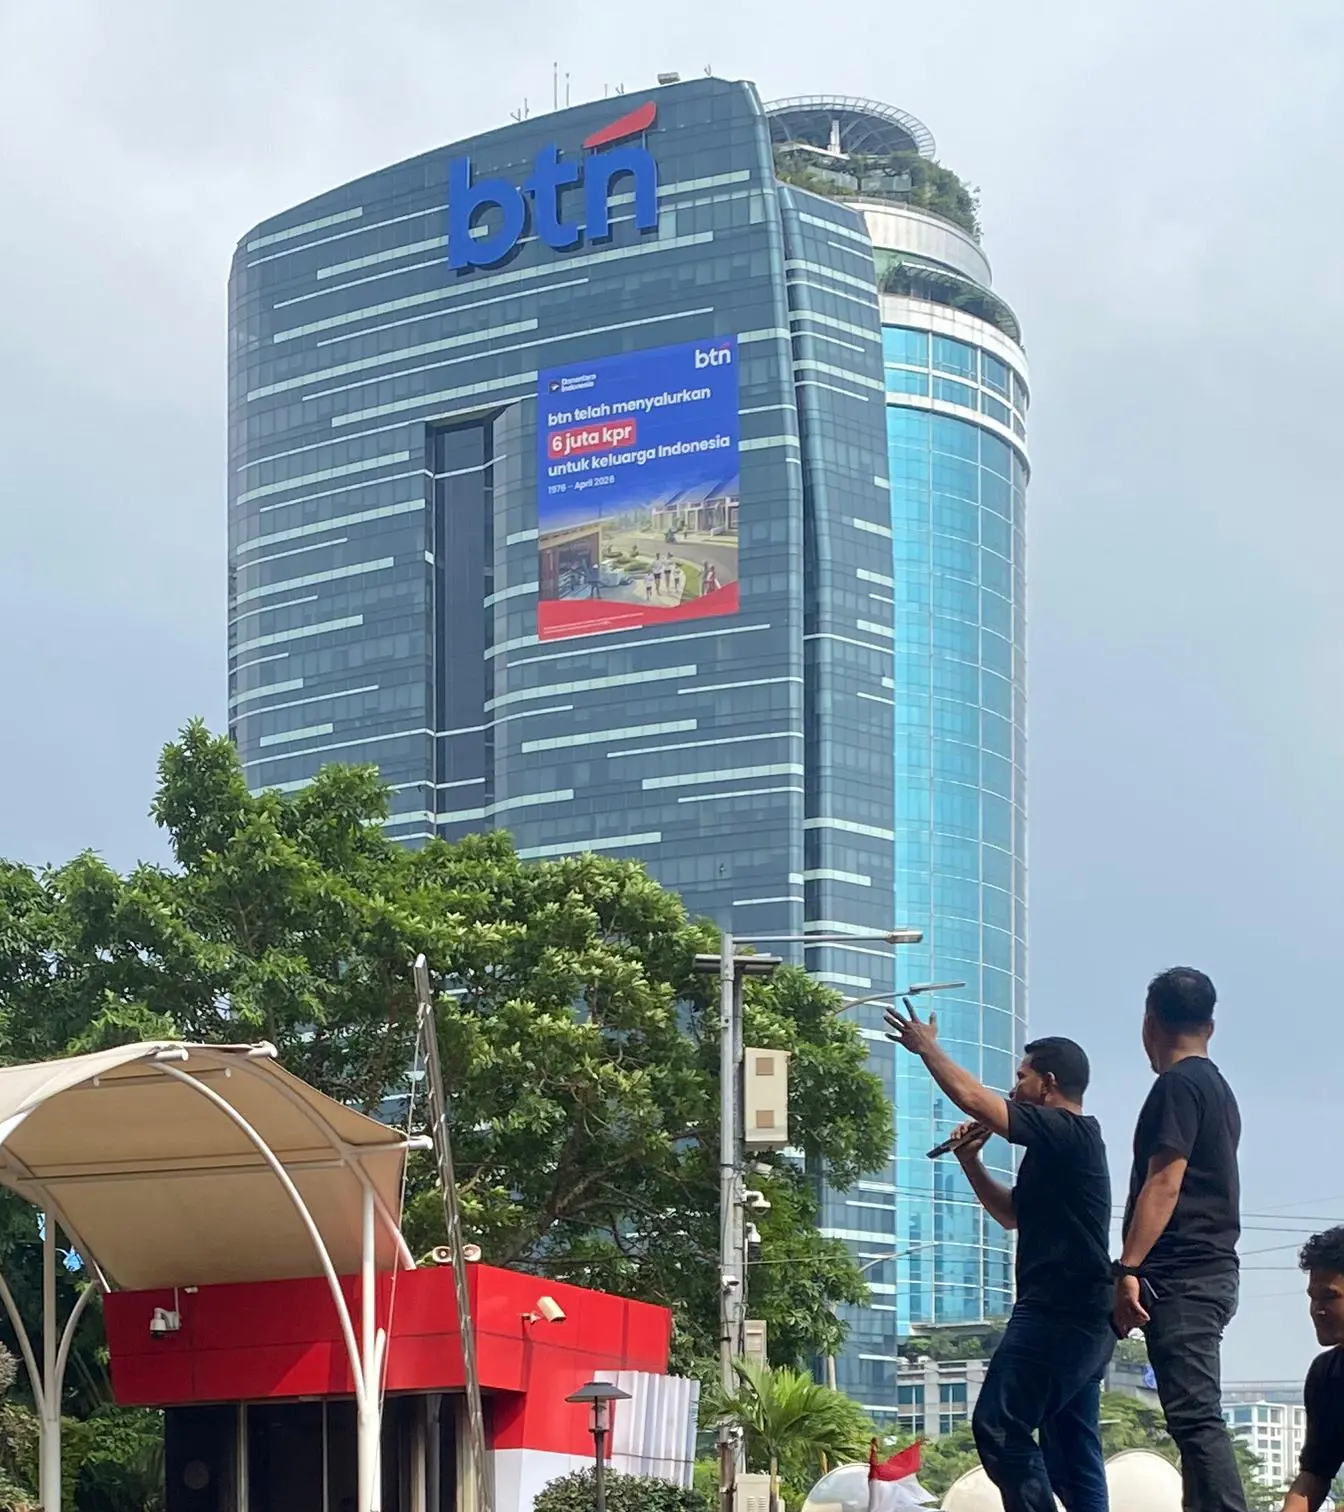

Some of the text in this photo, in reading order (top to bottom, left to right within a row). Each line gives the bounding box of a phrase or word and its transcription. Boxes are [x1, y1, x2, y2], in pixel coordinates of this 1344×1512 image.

[448, 140, 657, 270] btn
[695, 346, 731, 369] btn
[548, 387, 711, 427] btn telah menyalurkan
[548, 434, 730, 477] untuk keluarga Indonesia
[552, 424, 632, 455] 6 juta kpr
